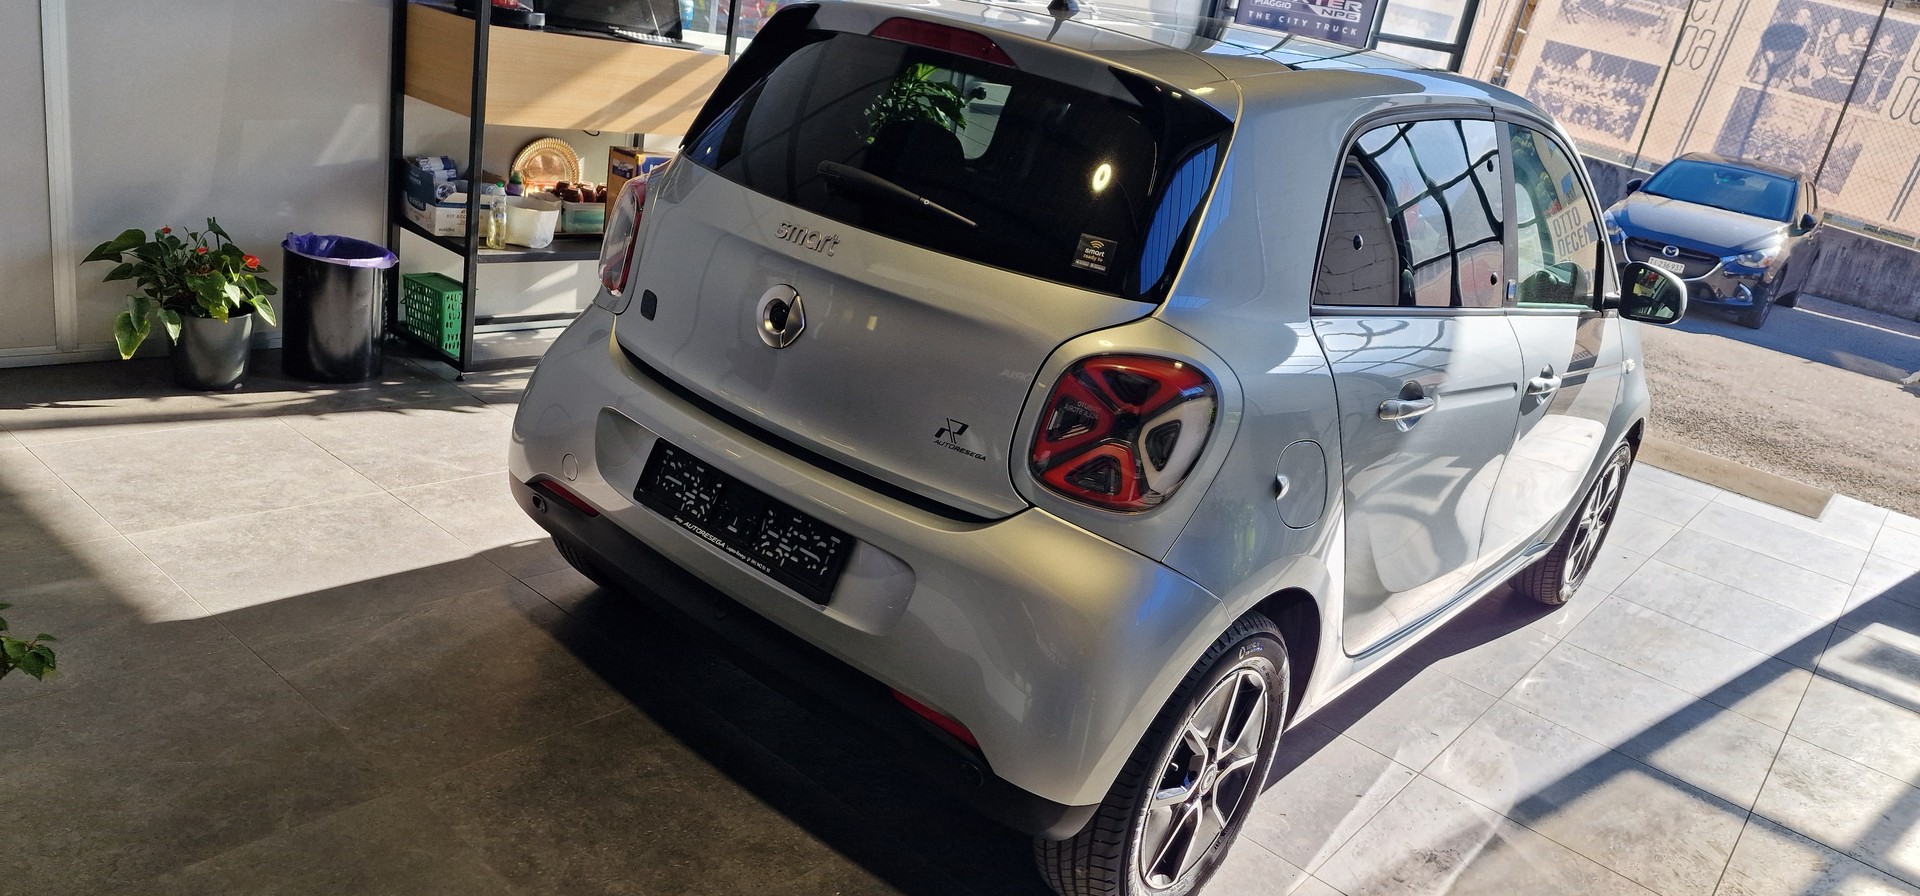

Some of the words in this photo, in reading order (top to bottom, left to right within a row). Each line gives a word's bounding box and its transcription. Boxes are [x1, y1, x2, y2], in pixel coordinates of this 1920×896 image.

[1248, 10, 1271, 20] THE
[1278, 16, 1308, 27] CITY
[1316, 22, 1357, 35] TRUCK
[1552, 206, 1582, 238] OTTO
[775, 221, 840, 257] smart
[1083, 254, 1098, 262] ready
[1084, 248, 1105, 257] smart
[933, 440, 987, 461] AUTORESEGA
[682, 521, 725, 548] AUTORESEGA
